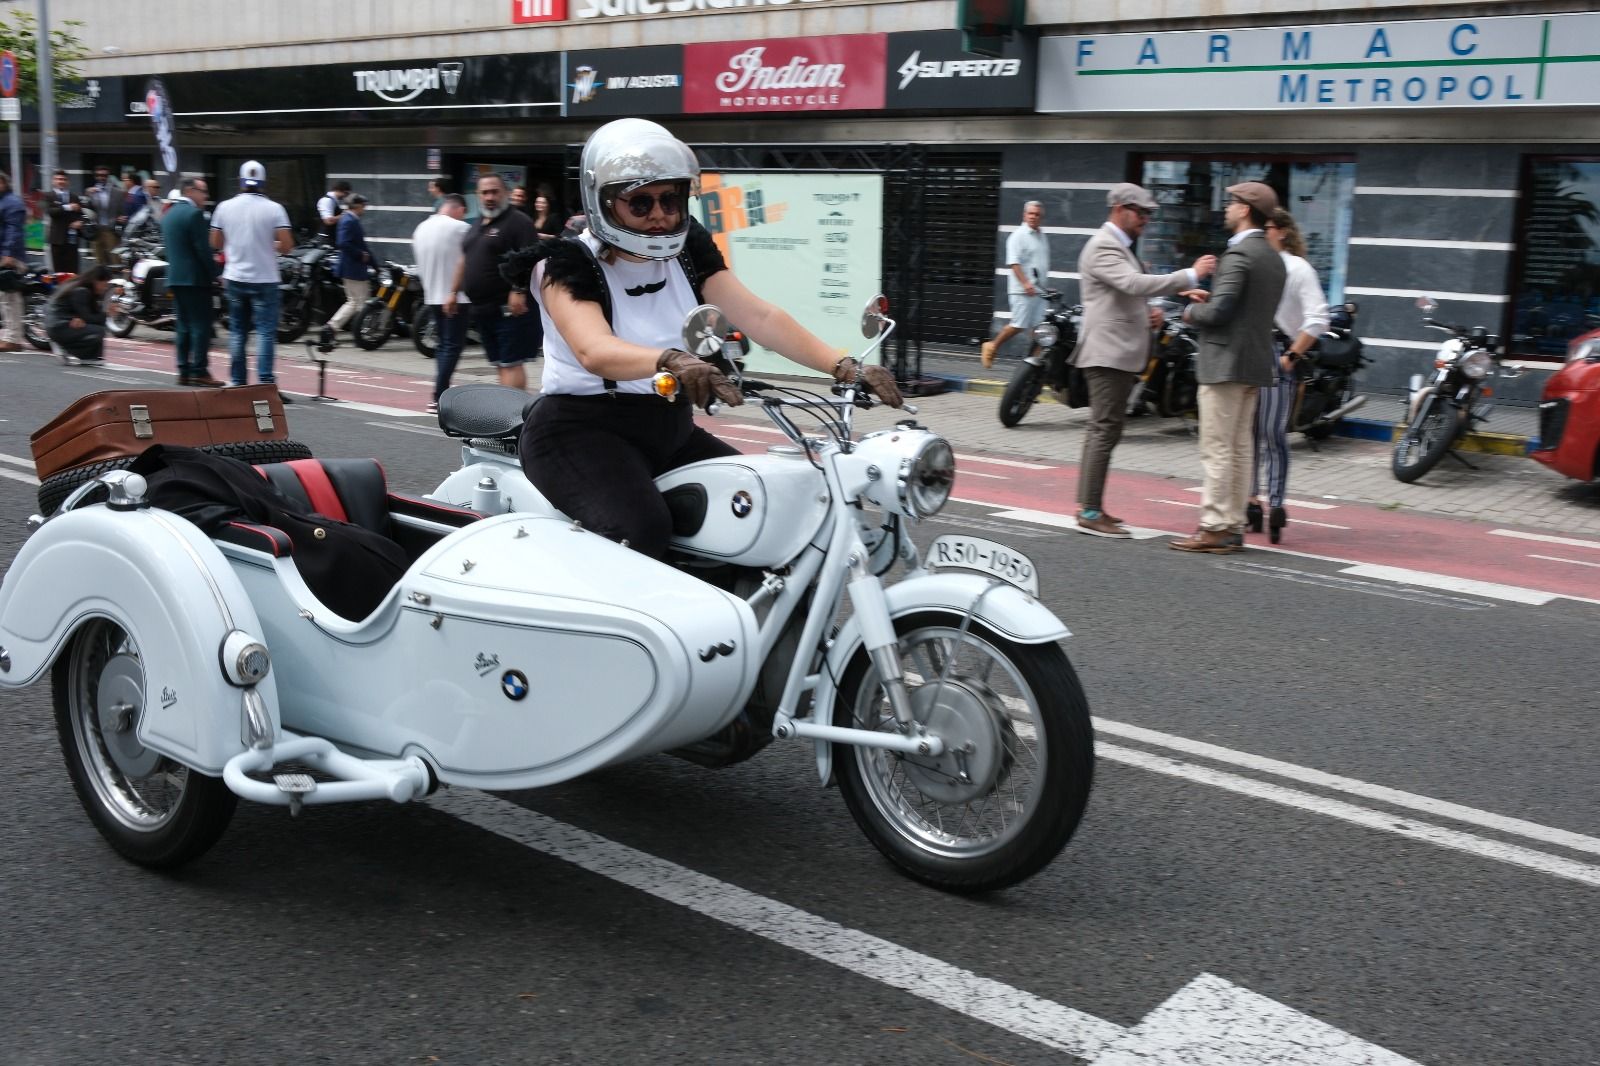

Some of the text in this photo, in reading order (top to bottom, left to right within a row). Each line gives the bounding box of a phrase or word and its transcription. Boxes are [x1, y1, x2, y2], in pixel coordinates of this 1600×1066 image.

[715, 47, 844, 92] Indian
[918, 59, 1021, 77] SUPER73
[353, 67, 440, 97] TRIUMPH
[627, 74, 681, 88] AGUSTA
[719, 95, 839, 106] MOTORCYCLE
[935, 542, 1033, 582] R50-1959
